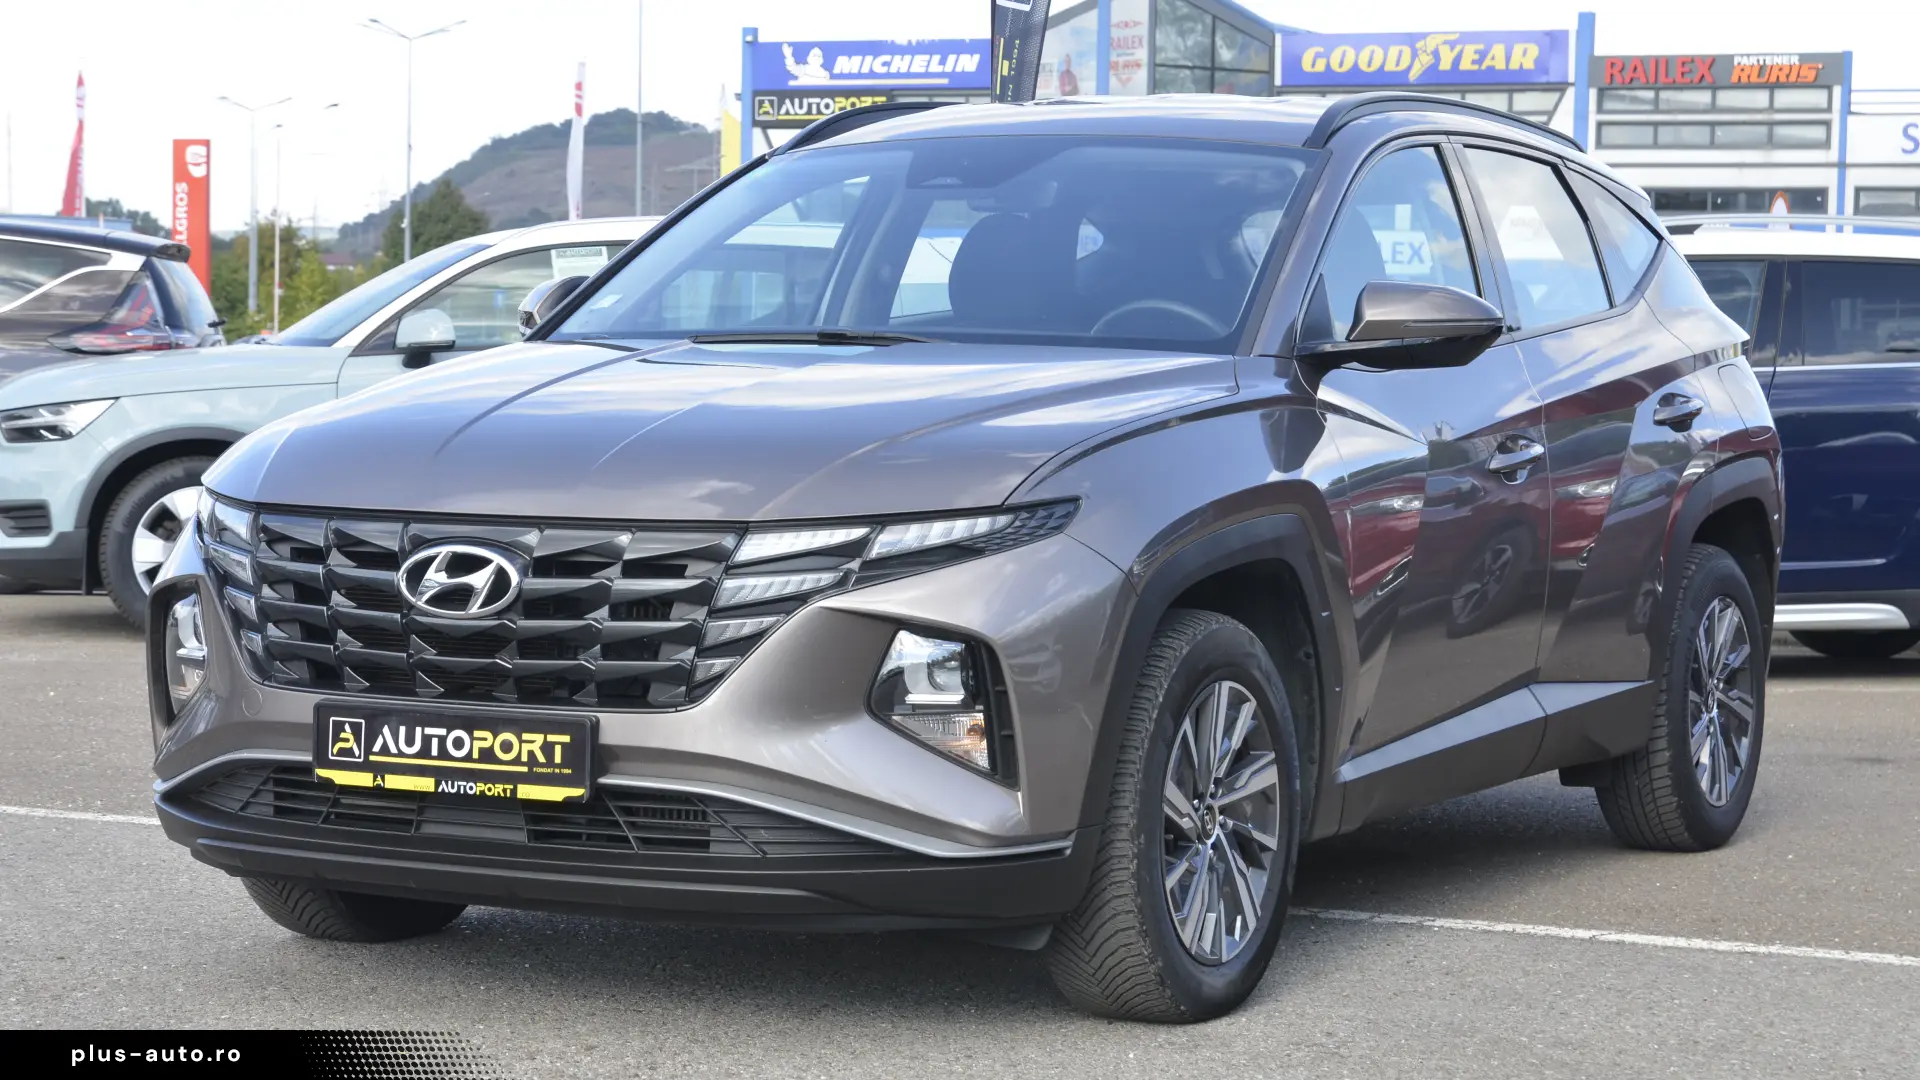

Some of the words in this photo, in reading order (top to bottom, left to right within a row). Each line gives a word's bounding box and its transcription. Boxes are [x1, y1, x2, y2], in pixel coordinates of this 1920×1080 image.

[833, 53, 980, 74] MICHELIN
[1604, 55, 1715, 84] RAILEX
[1733, 54, 1800, 65] PARTENER
[1730, 63, 1819, 84] RURIS
[175, 181, 188, 245] LGROS
[371, 724, 571, 764] AUTOPORT
[437, 780, 514, 798] AUTOPORT
